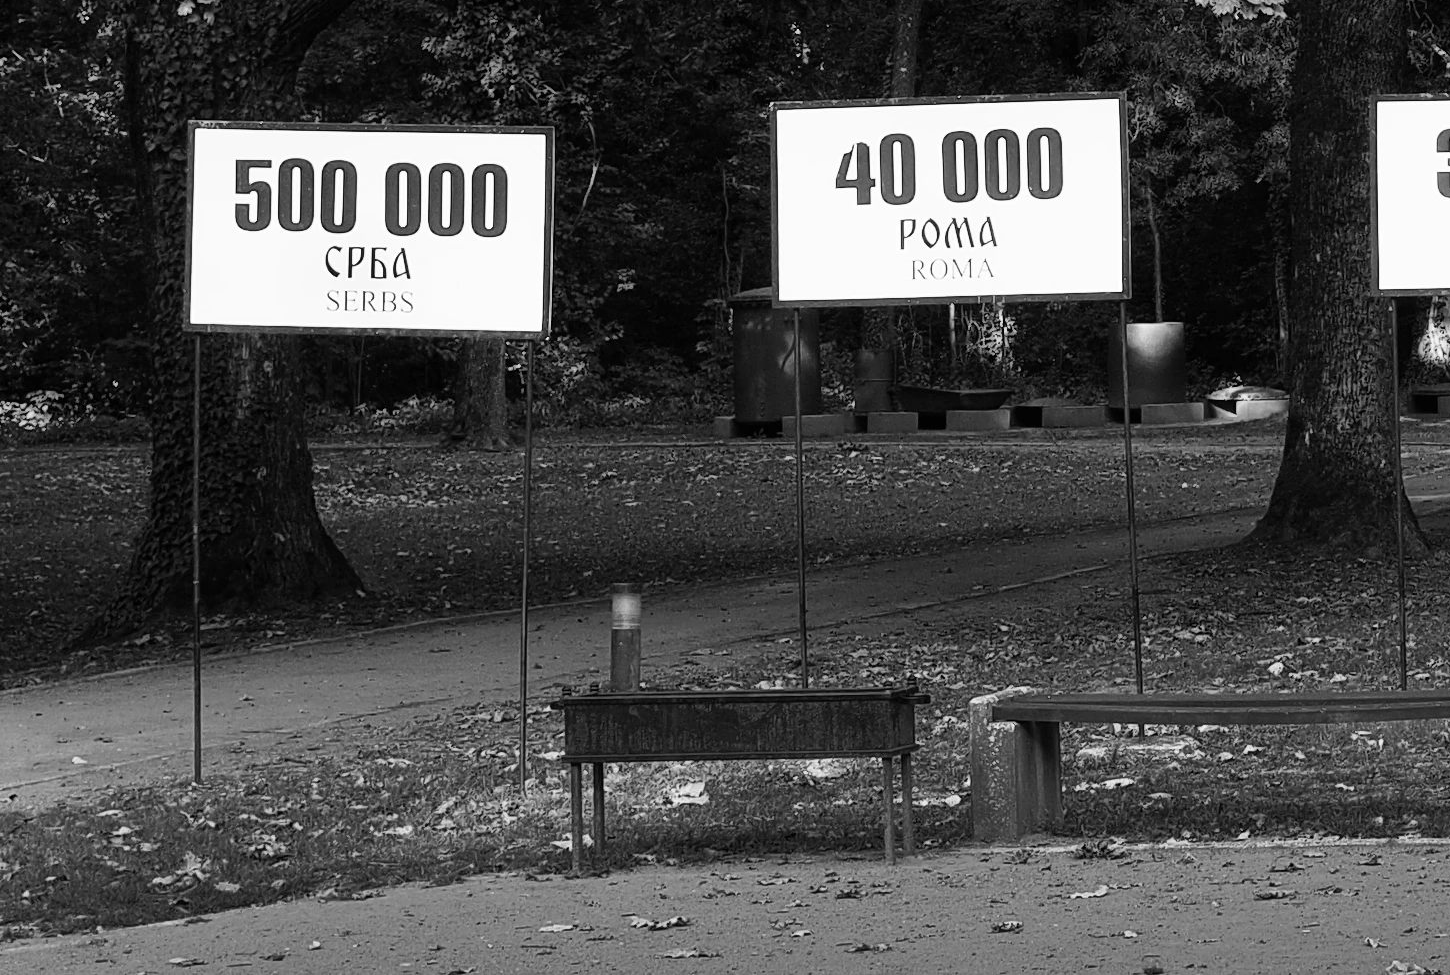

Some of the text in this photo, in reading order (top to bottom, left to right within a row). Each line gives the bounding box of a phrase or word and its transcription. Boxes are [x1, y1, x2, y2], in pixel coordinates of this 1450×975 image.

[835, 127, 1064, 206] 40 000
[235, 157, 508, 238] 500 000
[900, 216, 998, 250] РОМА
[325, 245, 411, 279] СРБА
[912, 258, 995, 280] ROMA
[327, 289, 413, 313] SERBS
